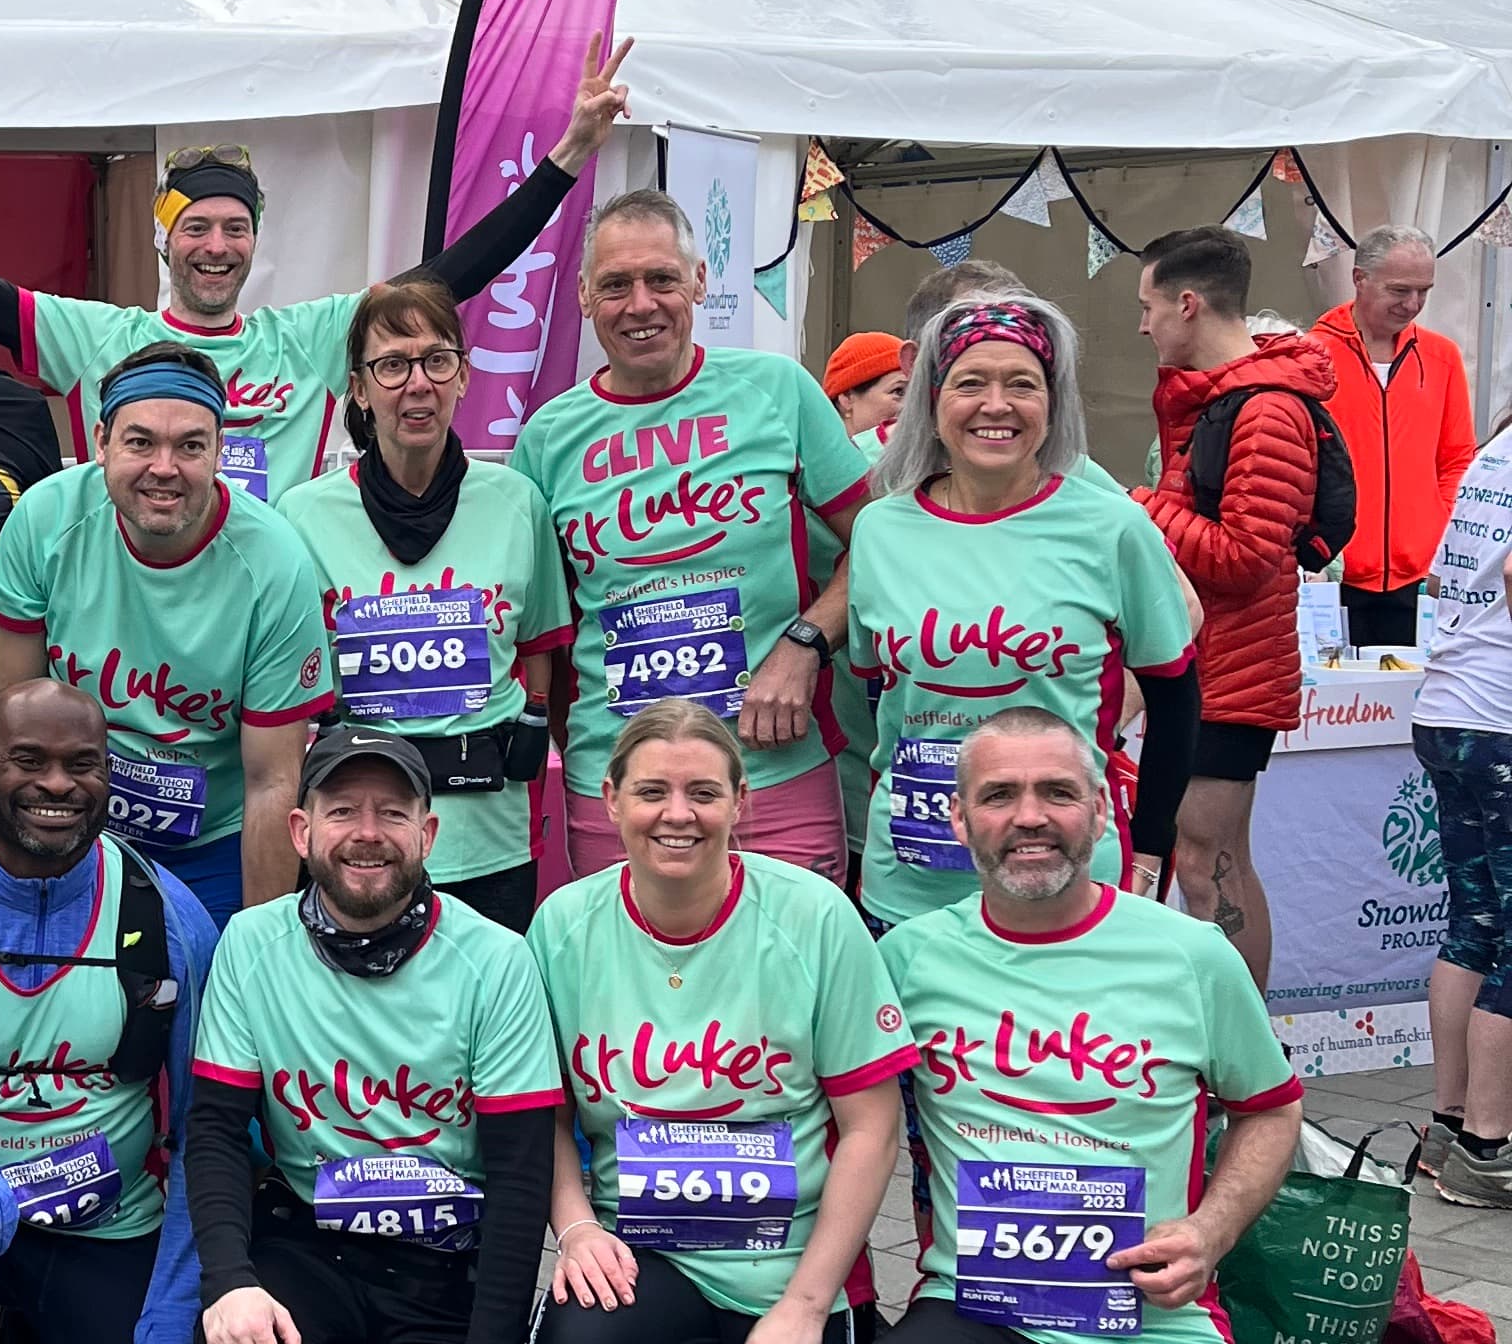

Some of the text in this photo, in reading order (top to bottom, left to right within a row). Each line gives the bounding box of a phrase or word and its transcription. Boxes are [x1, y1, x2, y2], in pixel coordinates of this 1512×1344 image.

[582, 414, 729, 483] CLIVE
[227, 456, 256, 468] 2023
[565, 470, 766, 575] St Luke's
[682, 566, 746, 587] Hospice
[381, 595, 430, 607] SHEFFIELD
[407, 602, 469, 615] MARATHON
[635, 601, 684, 616] SHEFFIELD
[437, 612, 471, 624] 2023
[636, 604, 726, 626] HALF MARATHON
[692, 615, 728, 630] 2023
[919, 604, 1081, 679] Luke's
[369, 637, 467, 675] 5068
[628, 642, 727, 682] 4982
[99, 647, 235, 731] Luke's
[1302, 688, 1395, 742] freedom
[131, 771, 193, 790] MARATHON
[157, 786, 192, 801] 2023
[108, 794, 180, 833] 027
[912, 791, 952, 823] 53
[1358, 891, 1450, 928] Snowd
[1380, 928, 1449, 951] PROJEC
[1346, 977, 1420, 996] survivors
[923, 1009, 1173, 1099] St Luke's
[1311, 1037, 1326, 1053] of
[1327, 1035, 1373, 1051] human
[572, 1019, 792, 1103] St Luke's
[272, 1058, 475, 1132] St Luke's
[40, 1126, 101, 1149] Hospice
[670, 1123, 727, 1134] SHEFFIELD
[956, 1121, 1131, 1153] Sheffield's Hospice
[702, 1134, 774, 1146] MARATHON
[735, 1144, 777, 1158] 2023
[3, 1158, 52, 1180] SHEFFIELD
[33, 1152, 95, 1184] MARATHON
[64, 1164, 101, 1186] 2023
[364, 1158, 418, 1170] SHEFFIELD
[1015, 1169, 1076, 1181] SHEFFIELD
[363, 1170, 394, 1181] HALF
[425, 1179, 466, 1193] 2023
[653, 1169, 772, 1204] 5619
[1015, 1180, 1125, 1195] HALF MARATHON
[1083, 1195, 1126, 1209] 2023
[347, 1203, 458, 1237] 4815
[1325, 1215, 1383, 1242] THIS
[745, 1238, 783, 1251] 5619
[992, 1222, 1115, 1262] 5679
[1301, 1237, 1358, 1265] NOT
[962, 1292, 1019, 1304] RUN FOR ALL
[1097, 1316, 1138, 1330] 5679
[1305, 1312, 1379, 1337] THIS IS
